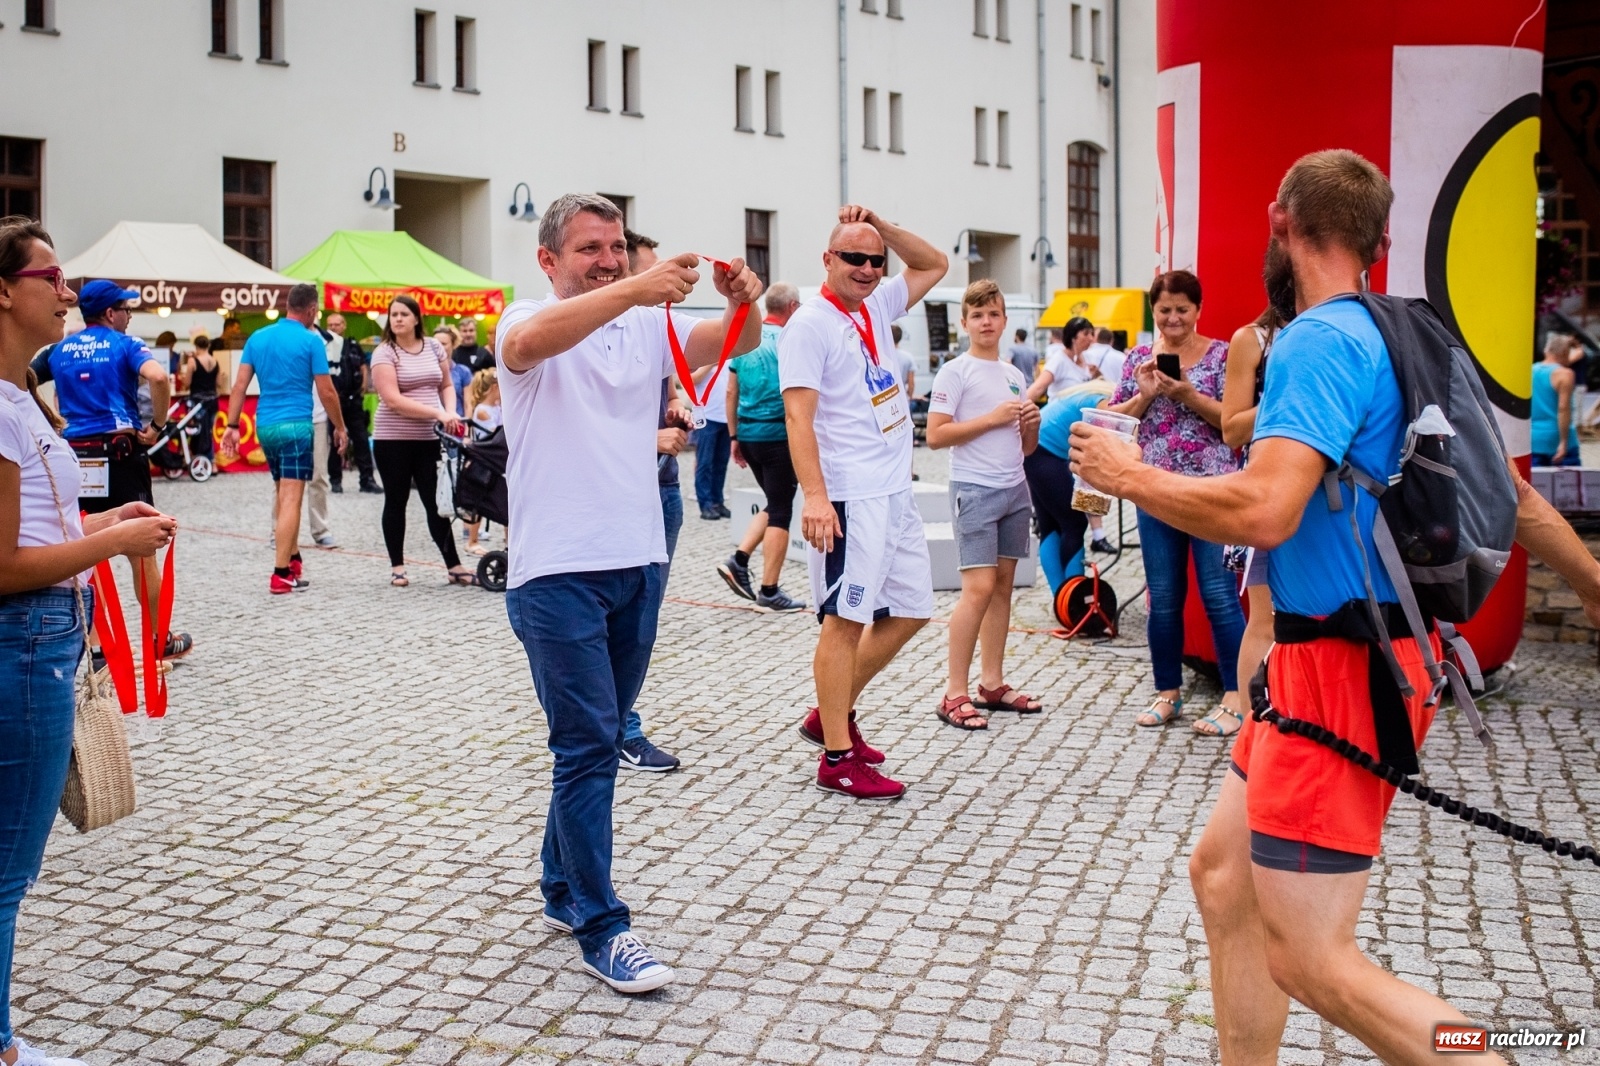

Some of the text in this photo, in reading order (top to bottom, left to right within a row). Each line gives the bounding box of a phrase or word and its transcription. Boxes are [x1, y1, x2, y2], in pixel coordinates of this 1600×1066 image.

[393, 132, 406, 152] B
[126, 280, 188, 309] gofry
[220, 283, 280, 310] gofry
[423, 293, 487, 312] LODOWE
[891, 403, 899, 417] 44
